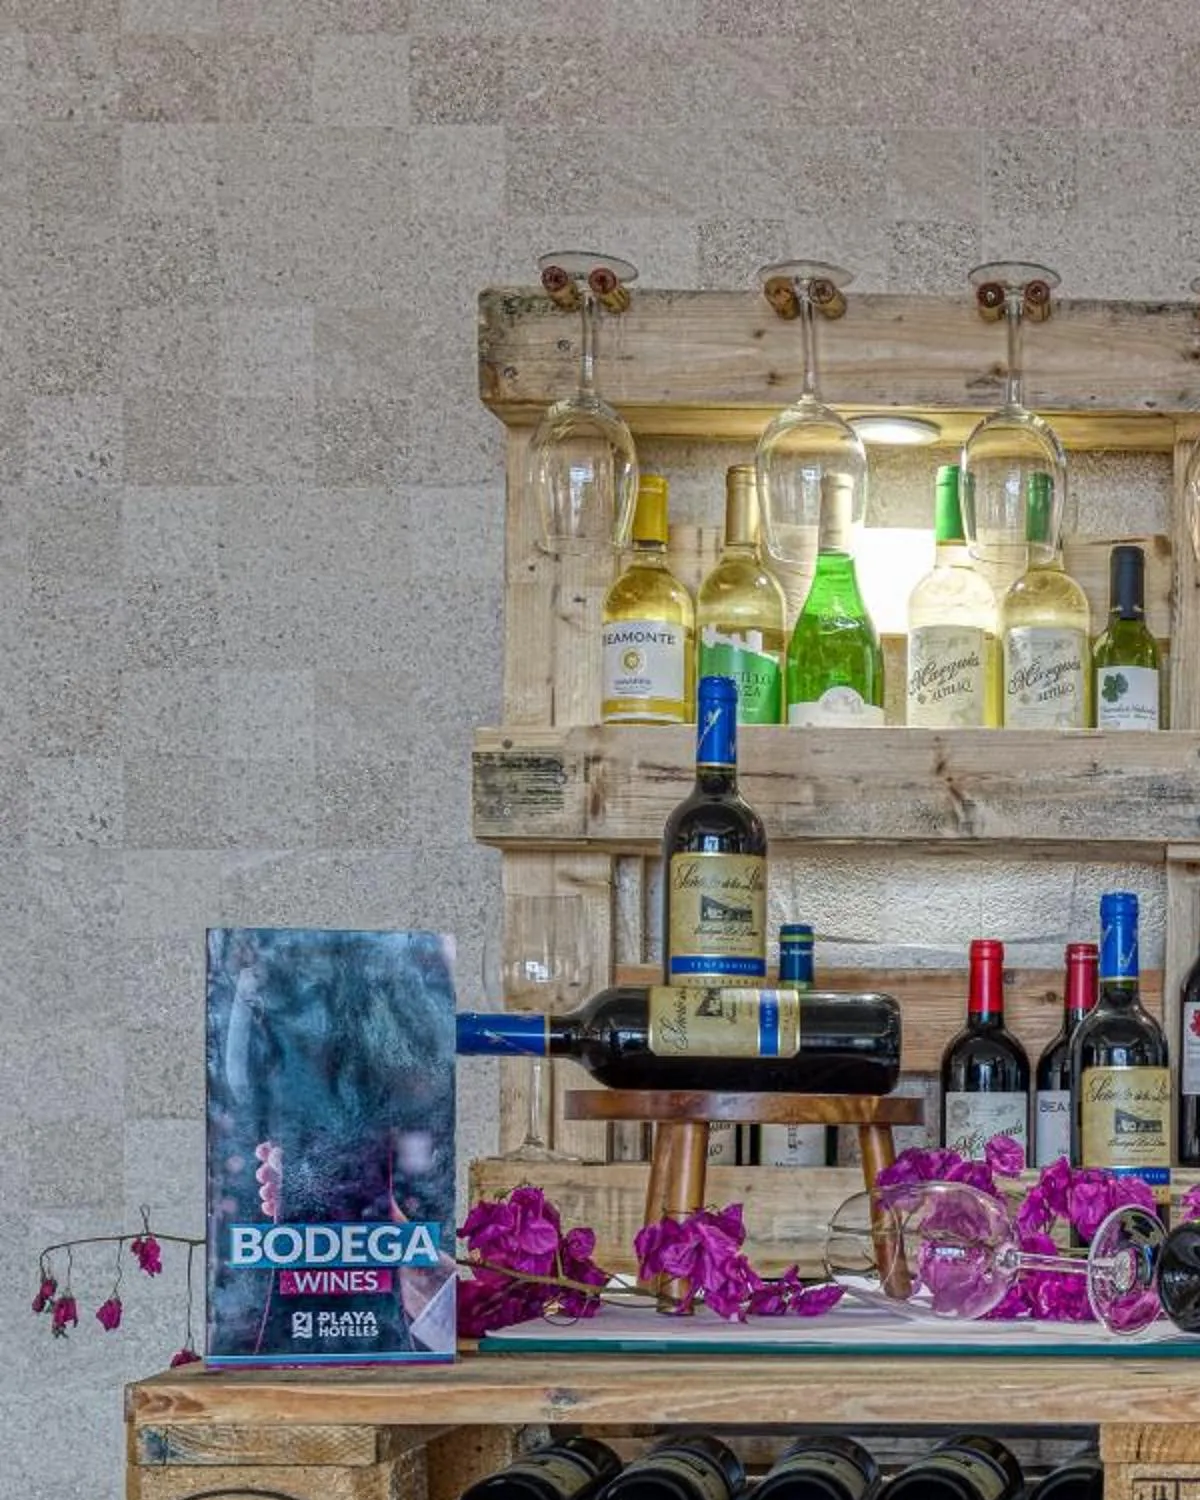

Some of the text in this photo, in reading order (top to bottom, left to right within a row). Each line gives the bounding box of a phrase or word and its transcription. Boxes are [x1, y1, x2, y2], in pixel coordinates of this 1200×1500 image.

[232, 1225, 439, 1264] BODEGA
[294, 1271, 379, 1293] WINES
[317, 1311, 378, 1325] PLAYA
[318, 1325, 379, 1338] HOTELES
